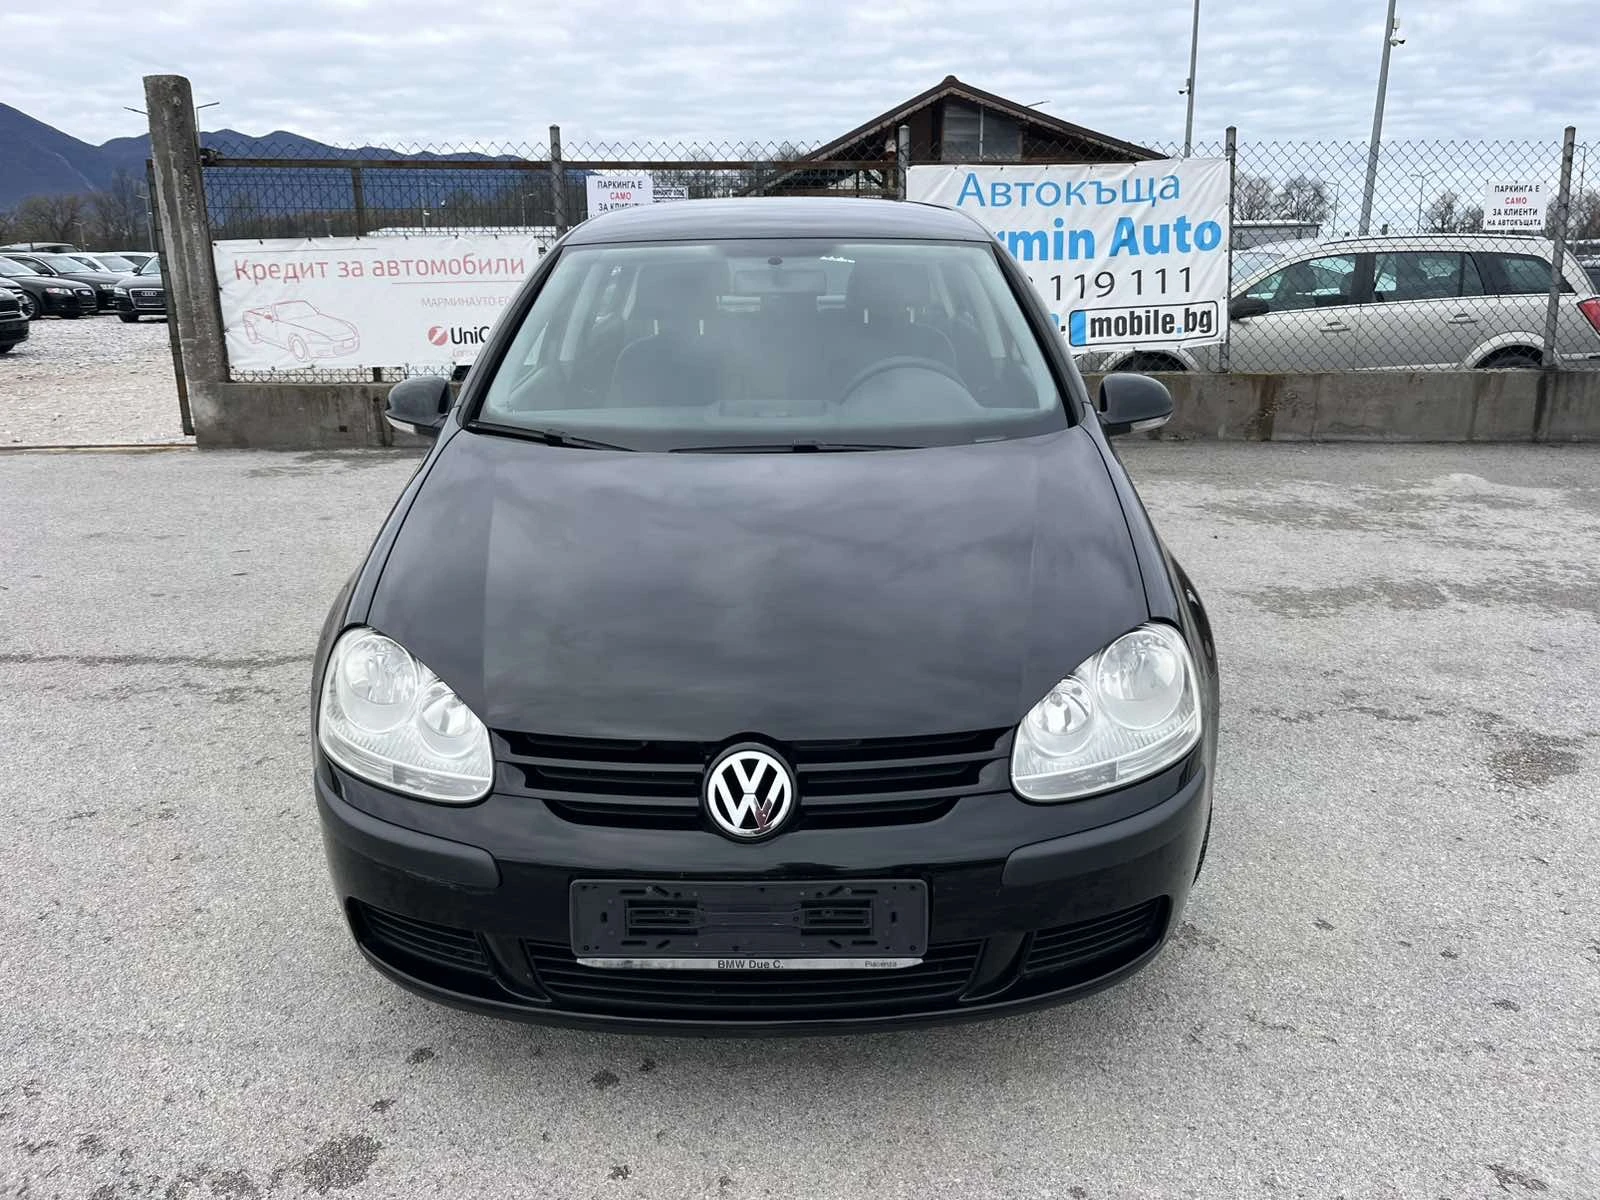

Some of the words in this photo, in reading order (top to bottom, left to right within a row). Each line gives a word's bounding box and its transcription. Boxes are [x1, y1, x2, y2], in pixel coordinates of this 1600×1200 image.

[597, 181, 636, 189] ПАРКИНГА
[638, 181, 643, 189] Е
[957, 172, 1180, 207] Автокъща
[610, 192, 632, 200] САМО
[599, 203, 609, 211] ЗА
[1109, 215, 1222, 257] Auto
[234, 259, 329, 285] Кредит
[338, 260, 364, 278] за
[372, 253, 525, 277] автомобили
[1050, 271, 1115, 300] 119
[1131, 266, 1191, 295] 111
[717, 959, 745, 969] BMW
[748, 959, 770, 969] Due
